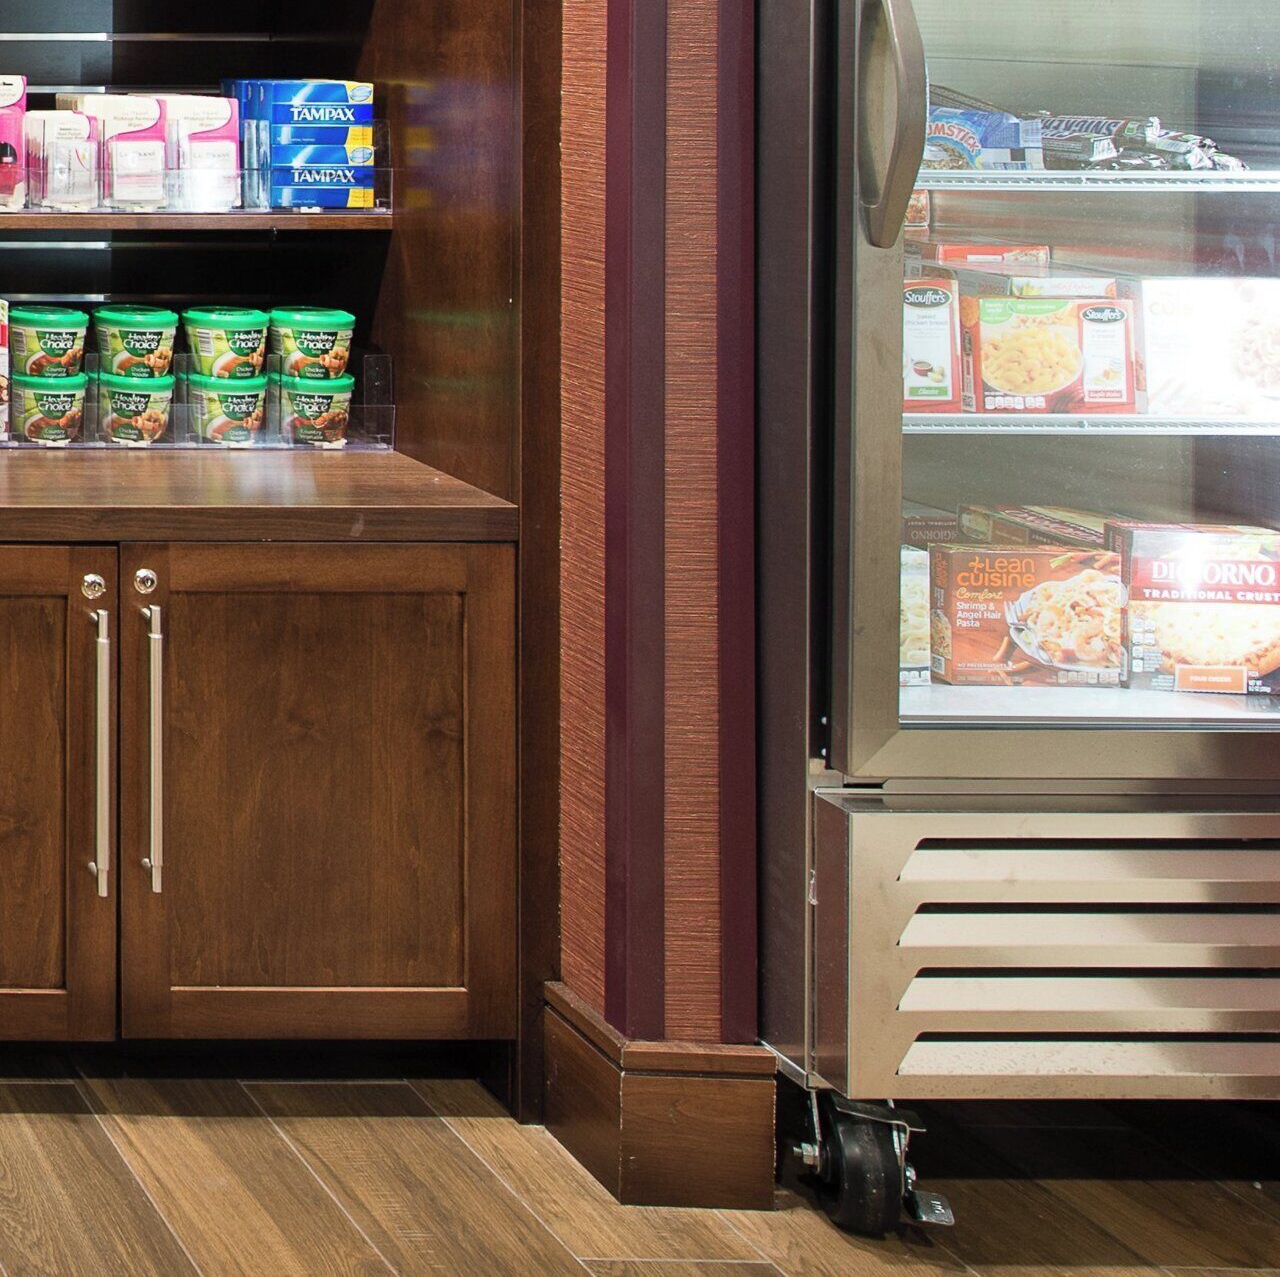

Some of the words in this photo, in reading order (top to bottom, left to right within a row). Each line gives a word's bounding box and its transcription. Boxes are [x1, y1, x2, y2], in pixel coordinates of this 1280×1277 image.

[290, 107, 355, 122] TAMPAX
[290, 169, 355, 183] TAMPAX
[904, 290, 946, 305] Stouffer's
[1084, 308, 1122, 321] Stouffer's
[40, 338, 73, 349] Choice
[123, 338, 158, 349] Choice
[229, 337, 260, 348] Choice
[296, 338, 333, 349] Choice
[38, 399, 71, 411] Choice
[111, 399, 146, 411] Choice
[222, 402, 255, 412] Choice
[293, 402, 328, 412] Choice
[986, 558, 1036, 572] Lean
[1151, 561, 1278, 586] DIORNO
[956, 586, 1003, 602] Comfort
[1236, 591, 1280, 602] CRUST
[956, 602, 987, 612] Shrimp
[989, 602, 996, 611] &
[956, 610, 983, 620] Angel
[984, 610, 1002, 620] Hair
[956, 619, 981, 628] Pasta
